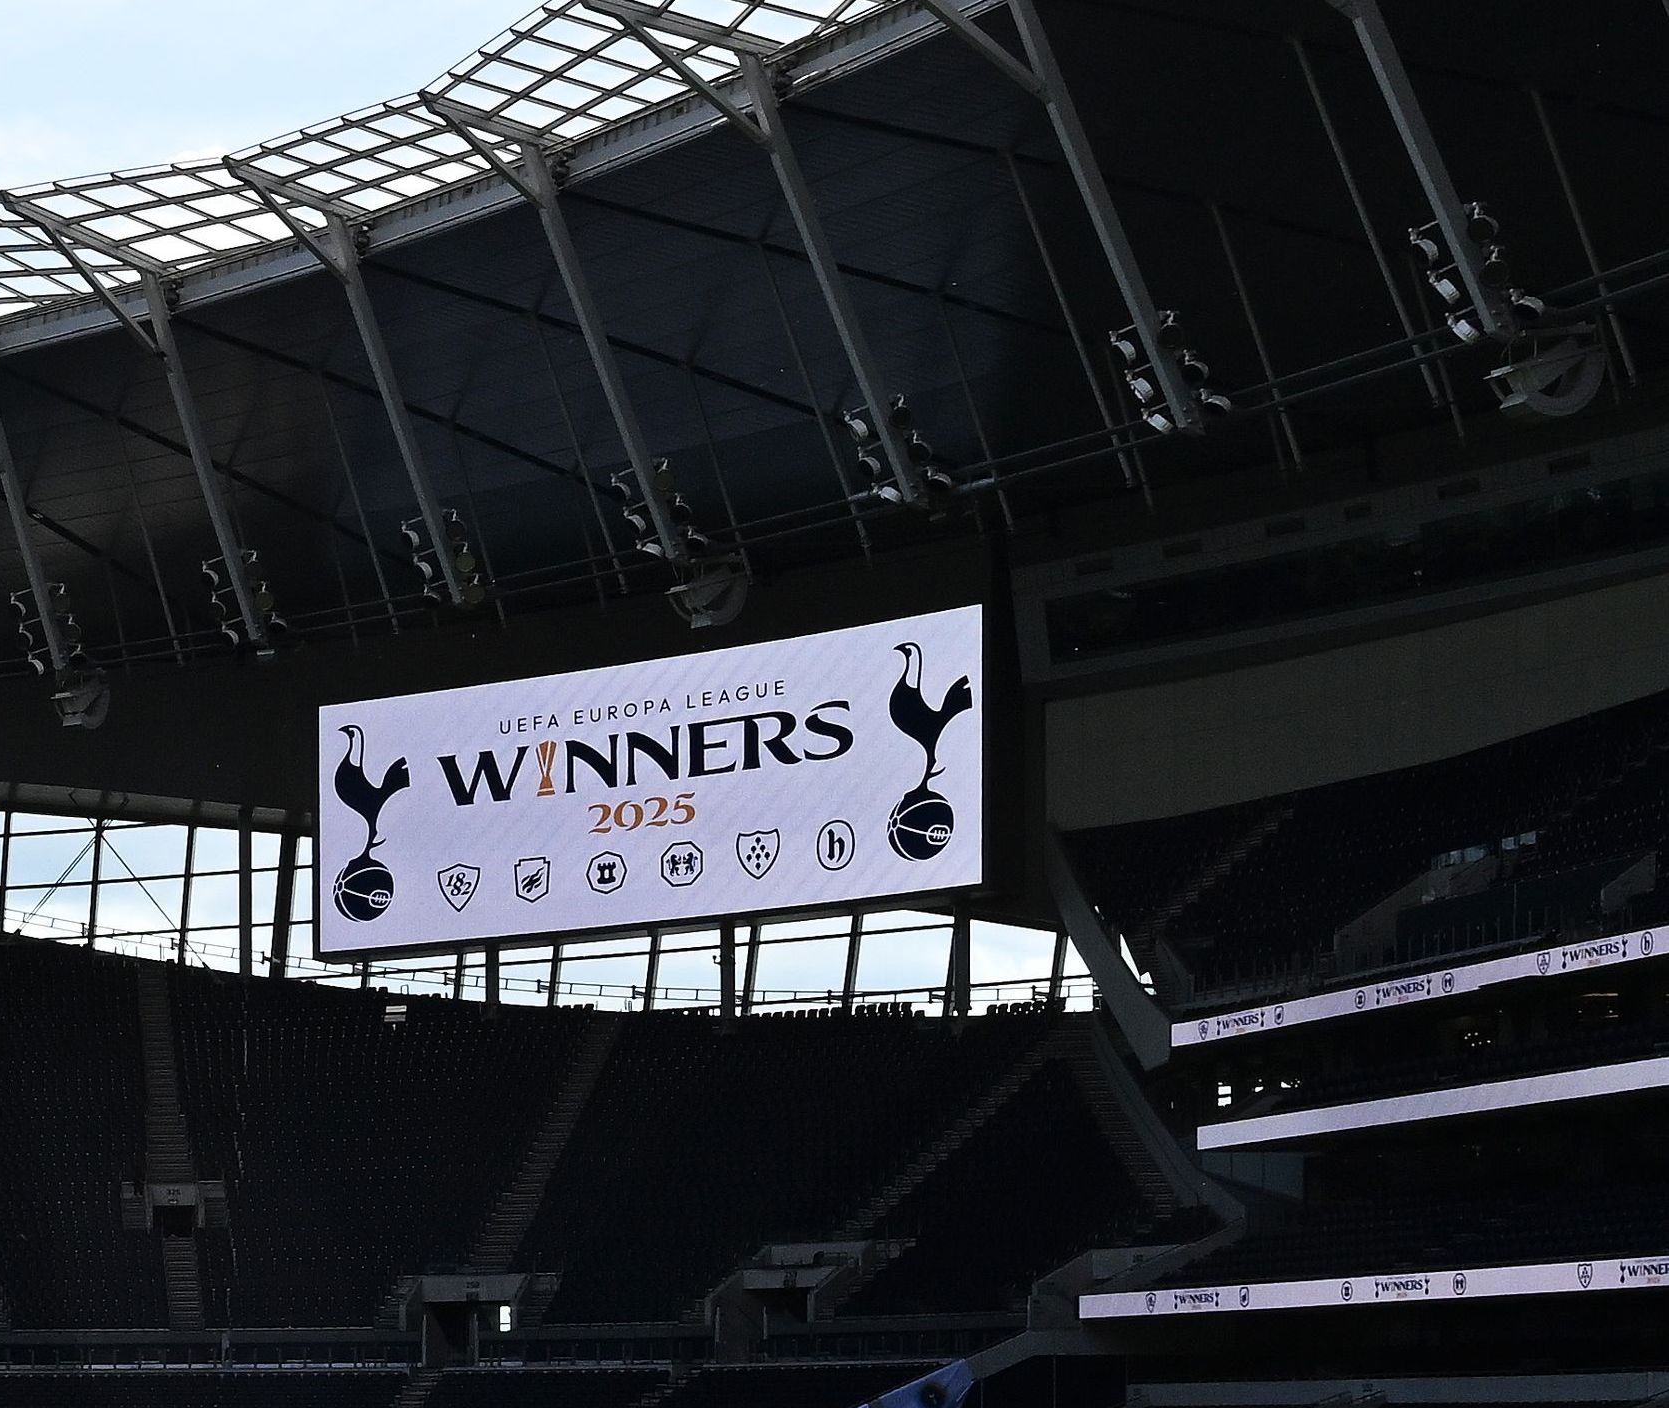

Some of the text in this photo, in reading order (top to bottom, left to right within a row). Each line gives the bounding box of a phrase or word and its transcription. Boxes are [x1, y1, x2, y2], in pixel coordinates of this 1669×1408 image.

[499, 679, 786, 735] UEFA EUROPA LEAGUE
[438, 700, 854, 807] WINNERS
[587, 792, 697, 834] 2025
[1569, 941, 1620, 961] WINNERS
